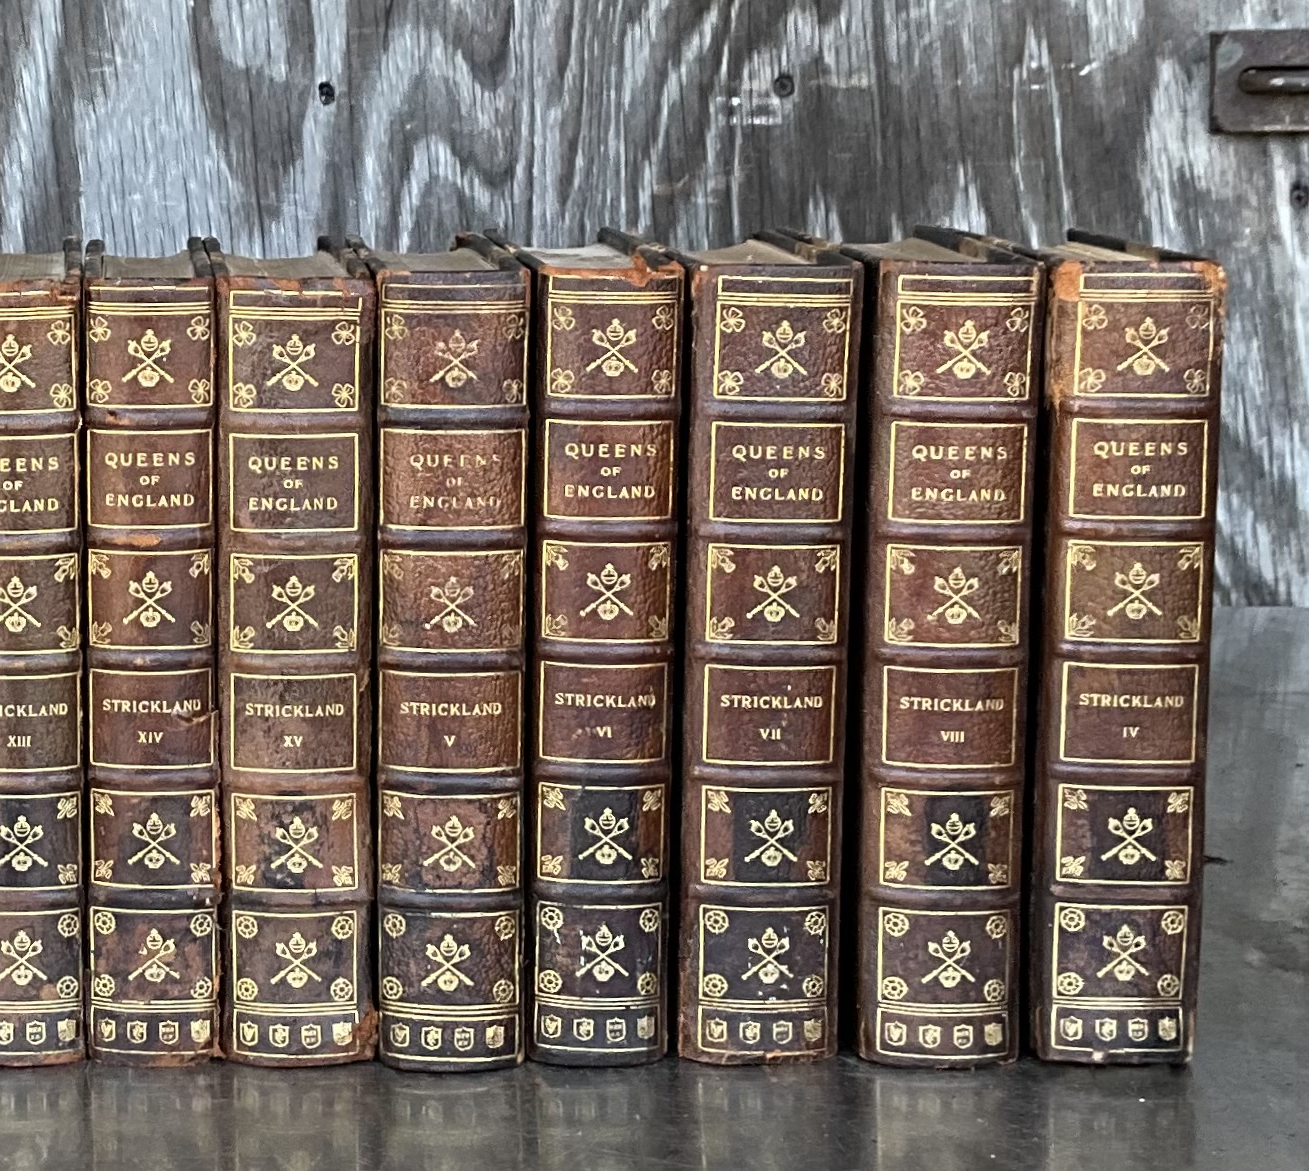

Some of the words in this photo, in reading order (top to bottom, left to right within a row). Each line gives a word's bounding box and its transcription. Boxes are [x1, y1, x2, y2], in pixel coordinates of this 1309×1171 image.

[564, 442, 658, 460] QUEENS
[731, 444, 827, 462] QUEENS
[911, 445, 1009, 463] QUEENS
[1093, 440, 1189, 458] QUEENS
[104, 452, 196, 469] QUEENS
[248, 455, 340, 473] QUEENS
[409, 453, 502, 470] QUEENS
[600, 466, 622, 477] OF
[767, 468, 790, 480] OF
[949, 469, 972, 480] OF
[1130, 464, 1151, 476] OF
[1, 480, 24, 492] OF
[139, 475, 161, 486] OF
[282, 478, 304, 490] OF
[563, 484, 656, 500] ENGLAND
[731, 485, 824, 502] ENGLAND
[910, 486, 1006, 502] ENGLAND
[1092, 482, 1187, 499] ENGLAND
[104, 493, 195, 509] ENGLAND
[248, 496, 339, 512] ENGLAND
[409, 495, 502, 510] ENGLAND
[102, 698, 202, 714] STRICKLAND
[554, 689, 657, 708] STRICKLAND
[720, 694, 824, 710] STRICKLAND
[899, 696, 1004, 712] STRICKLAND
[1078, 693, 1185, 709] STRICKLAND
[244, 702, 345, 718] STRICKLAND
[399, 701, 503, 717] STRICKLAND
[137, 731, 164, 744] XIV
[596, 725, 613, 739] VI
[759, 727, 782, 741] VII
[940, 730, 966, 743] VIII
[1122, 726, 1139, 739] IV
[7, 734, 32, 748] XIII
[282, 735, 303, 748] XV
[444, 734, 456, 748] V
